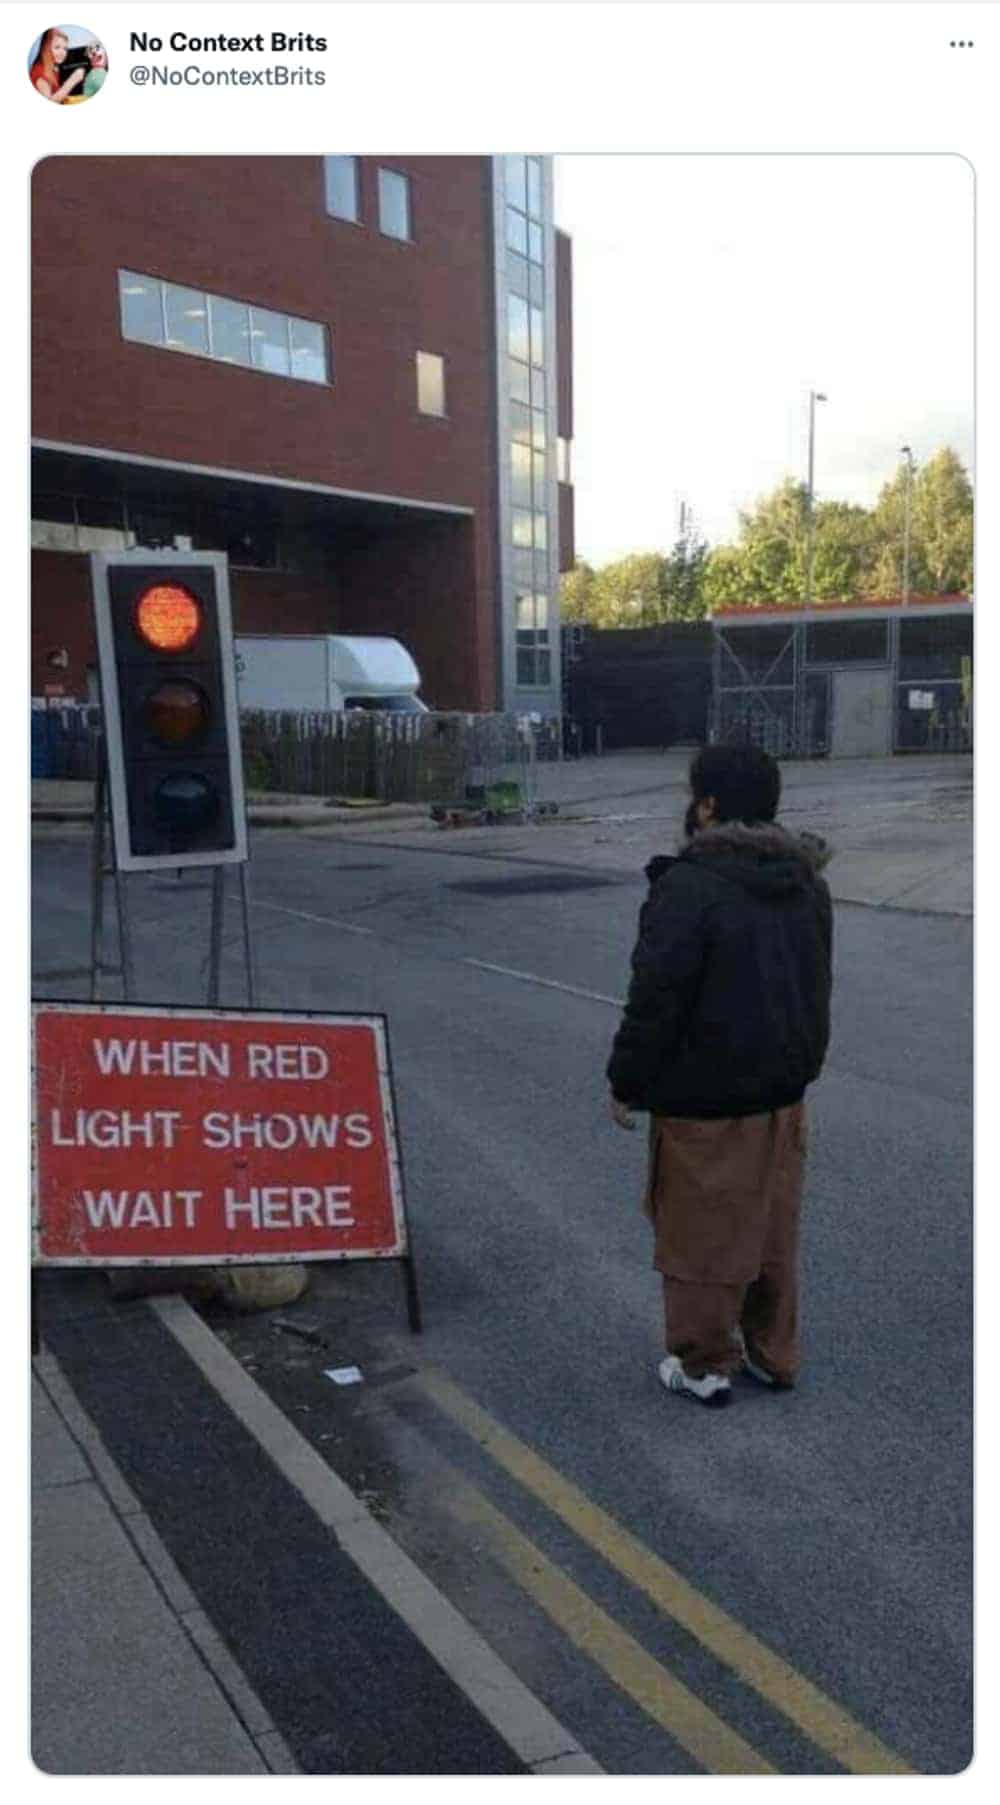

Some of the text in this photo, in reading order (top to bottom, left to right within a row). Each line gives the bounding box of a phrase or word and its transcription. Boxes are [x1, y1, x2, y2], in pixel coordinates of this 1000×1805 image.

[92, 1038, 329, 1080] WHEN RED
[50, 1108, 373, 1149] LIGHT SHOWS
[82, 1185, 355, 1230] WAIT HERE
